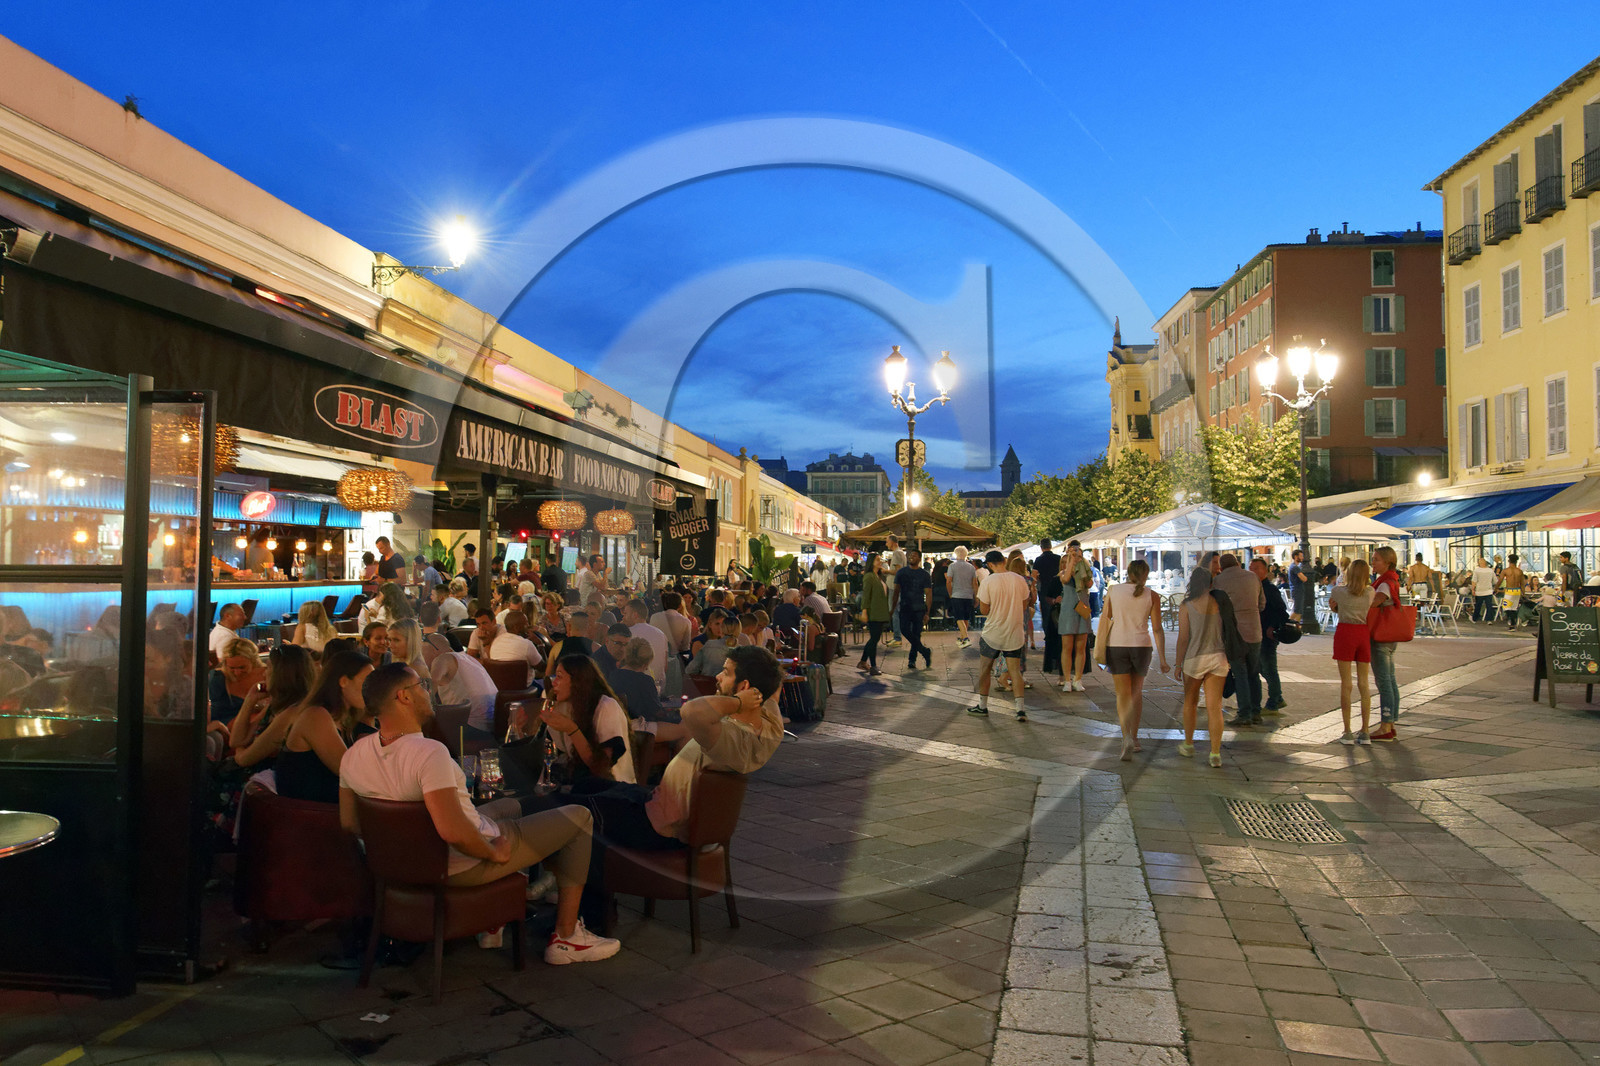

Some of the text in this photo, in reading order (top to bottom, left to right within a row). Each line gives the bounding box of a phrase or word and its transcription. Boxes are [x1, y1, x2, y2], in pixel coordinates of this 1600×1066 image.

[336, 390, 425, 441] BLAST
[456, 419, 640, 498] AMERICAN BAR FOOD NON STOP
[669, 507, 703, 525] SNAC
[669, 518, 710, 539] BURGER
[681, 538, 689, 552] 7
[1551, 612, 1597, 631] Socca
